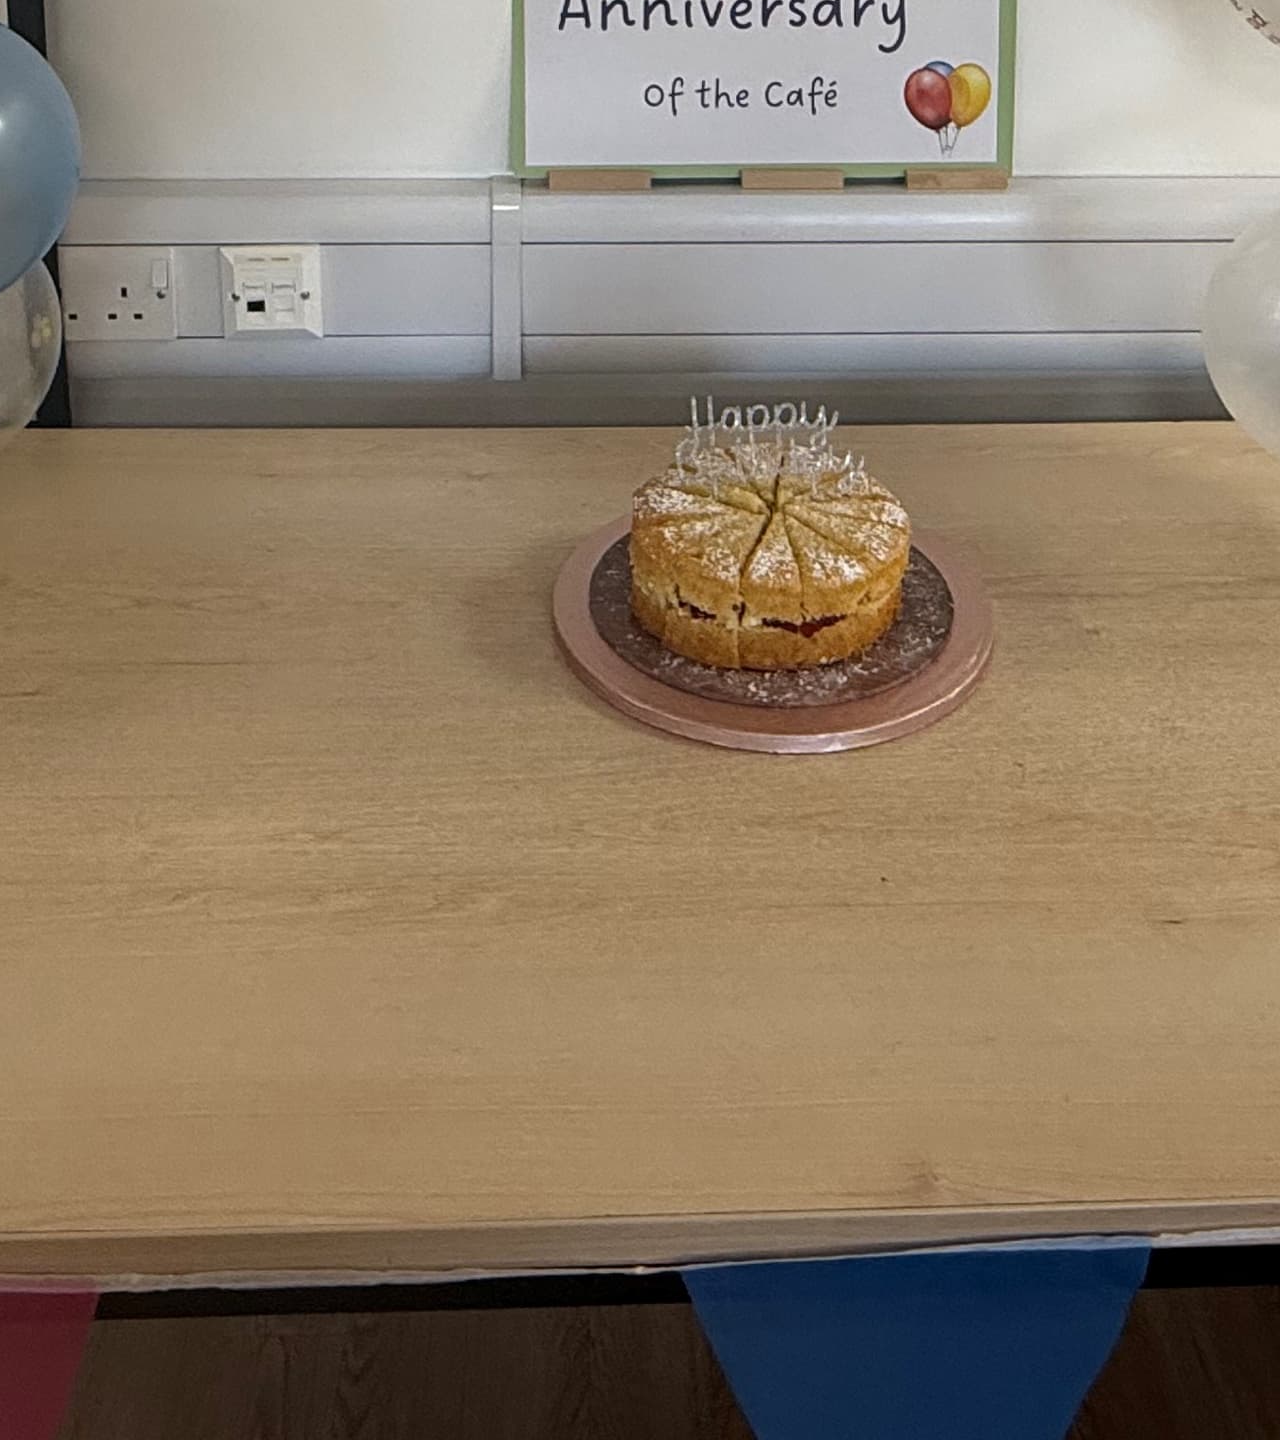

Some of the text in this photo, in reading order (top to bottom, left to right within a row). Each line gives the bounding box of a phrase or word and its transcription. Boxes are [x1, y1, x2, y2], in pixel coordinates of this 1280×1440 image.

[643, 76, 839, 116] Of the Café
[685, 395, 840, 450] Happy
